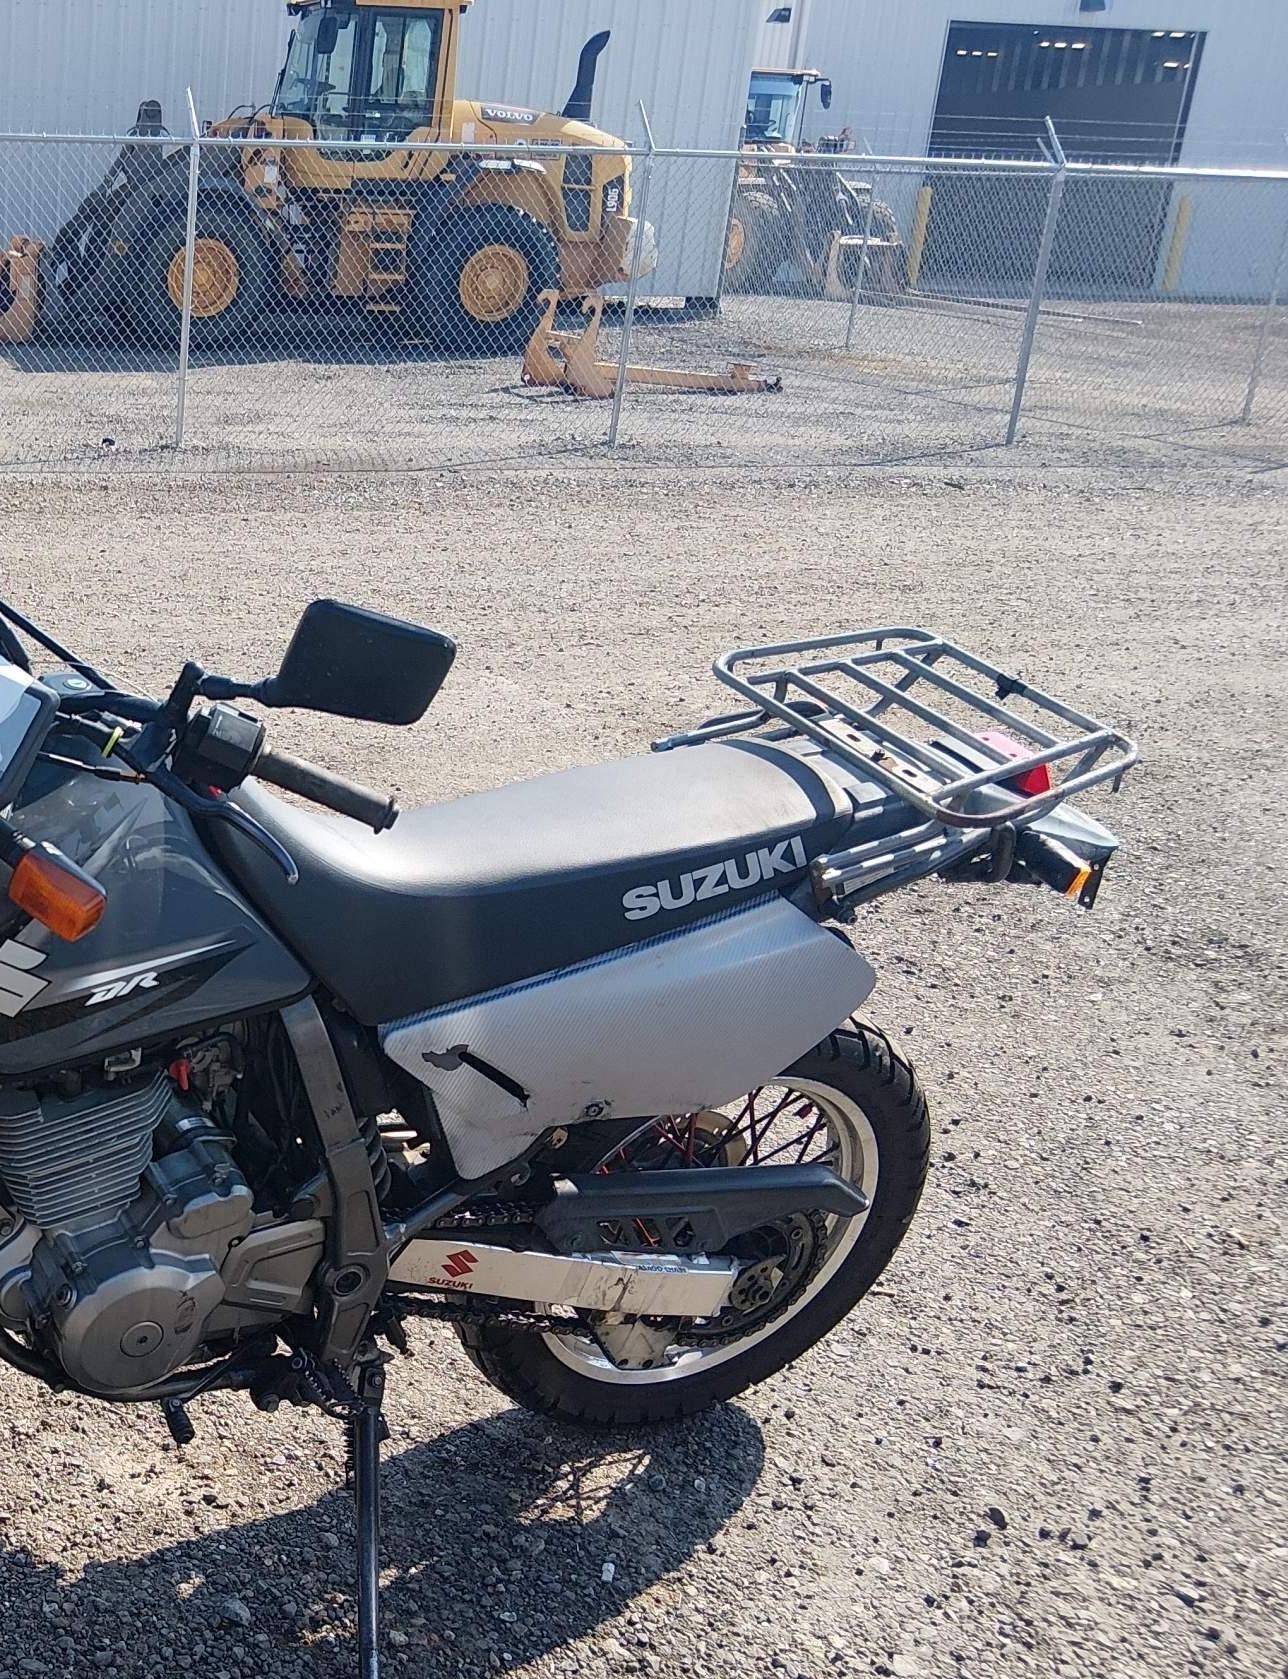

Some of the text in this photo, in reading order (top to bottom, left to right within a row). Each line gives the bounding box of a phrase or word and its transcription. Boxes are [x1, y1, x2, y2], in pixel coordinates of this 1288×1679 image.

[485, 108, 534, 121] VOLVO
[606, 188, 619, 212] L90G
[622, 835, 808, 921] SUZUKI
[84, 971, 160, 1007] DR
[428, 1276, 473, 1290] SUZUKI
